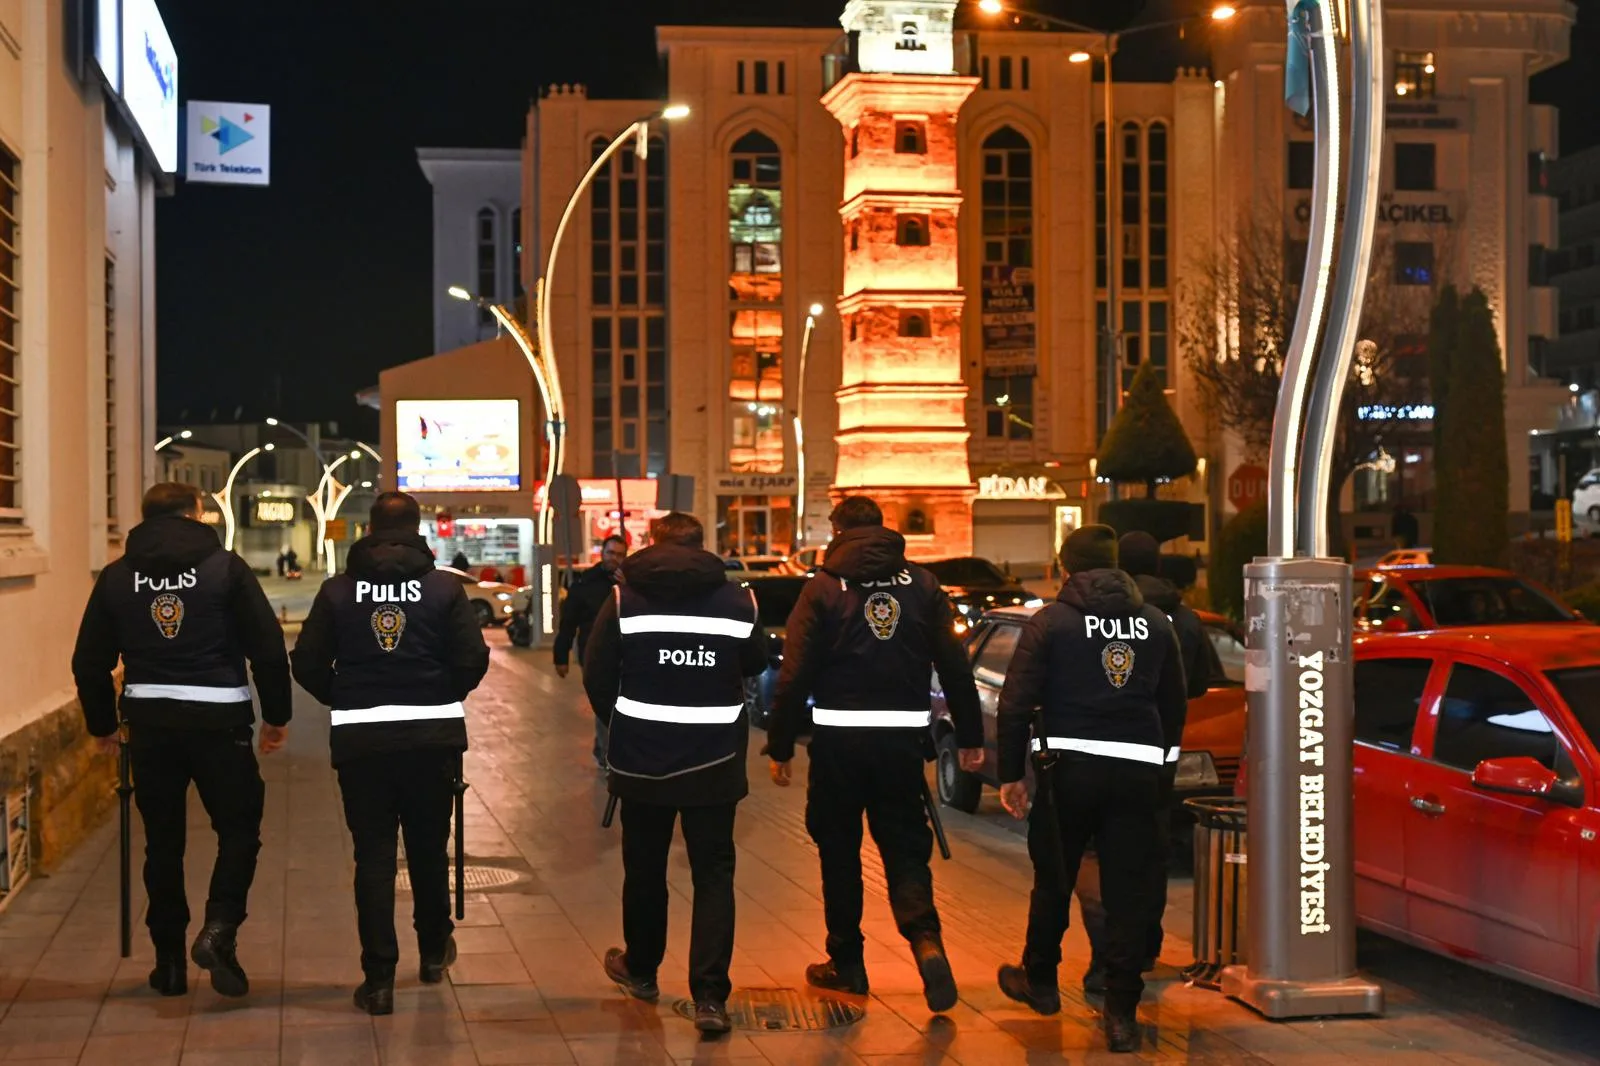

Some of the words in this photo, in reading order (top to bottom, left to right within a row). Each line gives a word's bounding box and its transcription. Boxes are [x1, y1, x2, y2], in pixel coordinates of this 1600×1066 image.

[193, 162, 216, 172] Türk
[219, 163, 263, 174] Telekom
[658, 645, 716, 667] POLİS
[1298, 650, 1325, 767] YOZGAT
[1299, 773, 1331, 935] BELEDİYESİ
